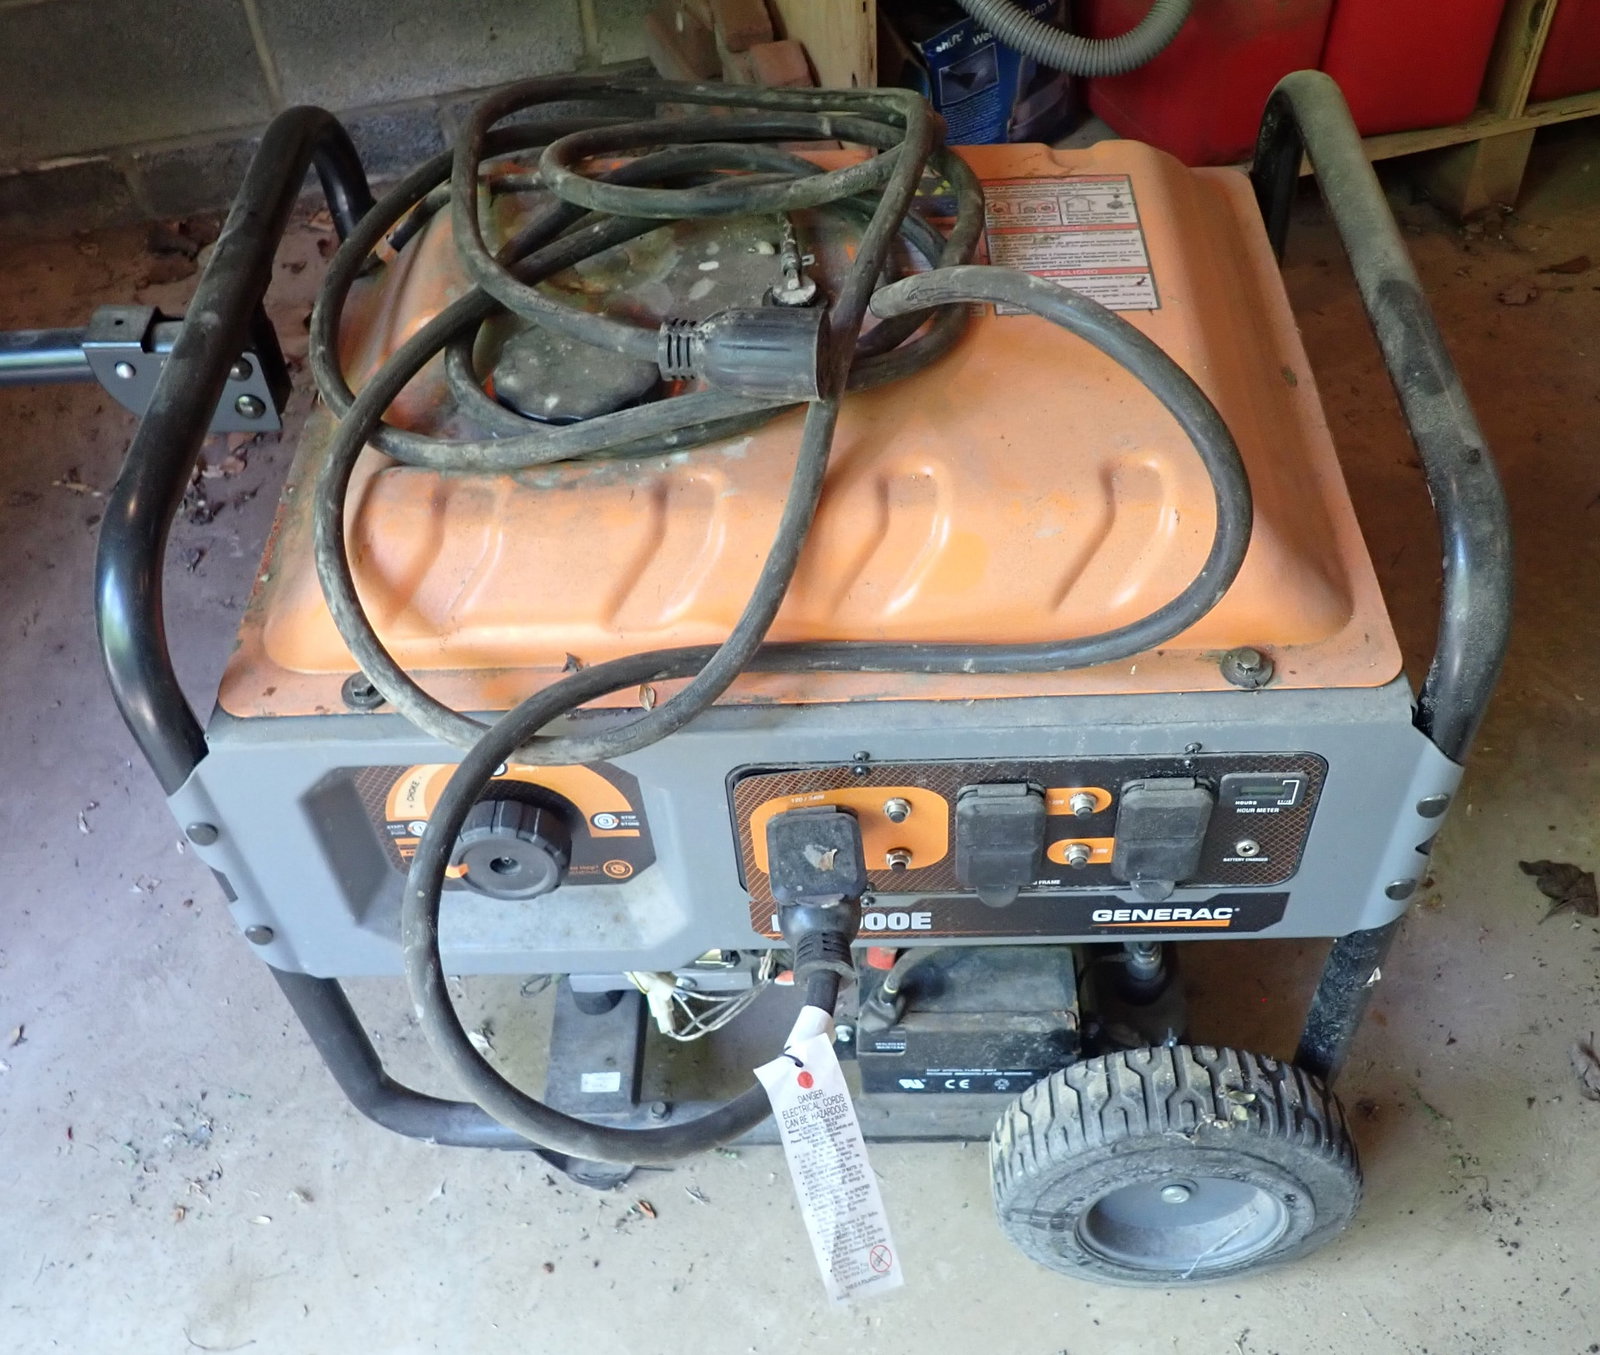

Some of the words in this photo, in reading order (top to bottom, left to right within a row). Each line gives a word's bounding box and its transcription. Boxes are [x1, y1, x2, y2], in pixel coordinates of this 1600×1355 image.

[407, 780, 420, 801] CHOKE
[1092, 907, 1233, 922] GENERAC
[782, 1101, 820, 1120] ELECTRICAL
[822, 1093, 845, 1107] CORDS
[784, 1119, 800, 1129] CAN
[799, 1115, 809, 1125] BE
[811, 1102, 848, 1121] HAZARDOUS
